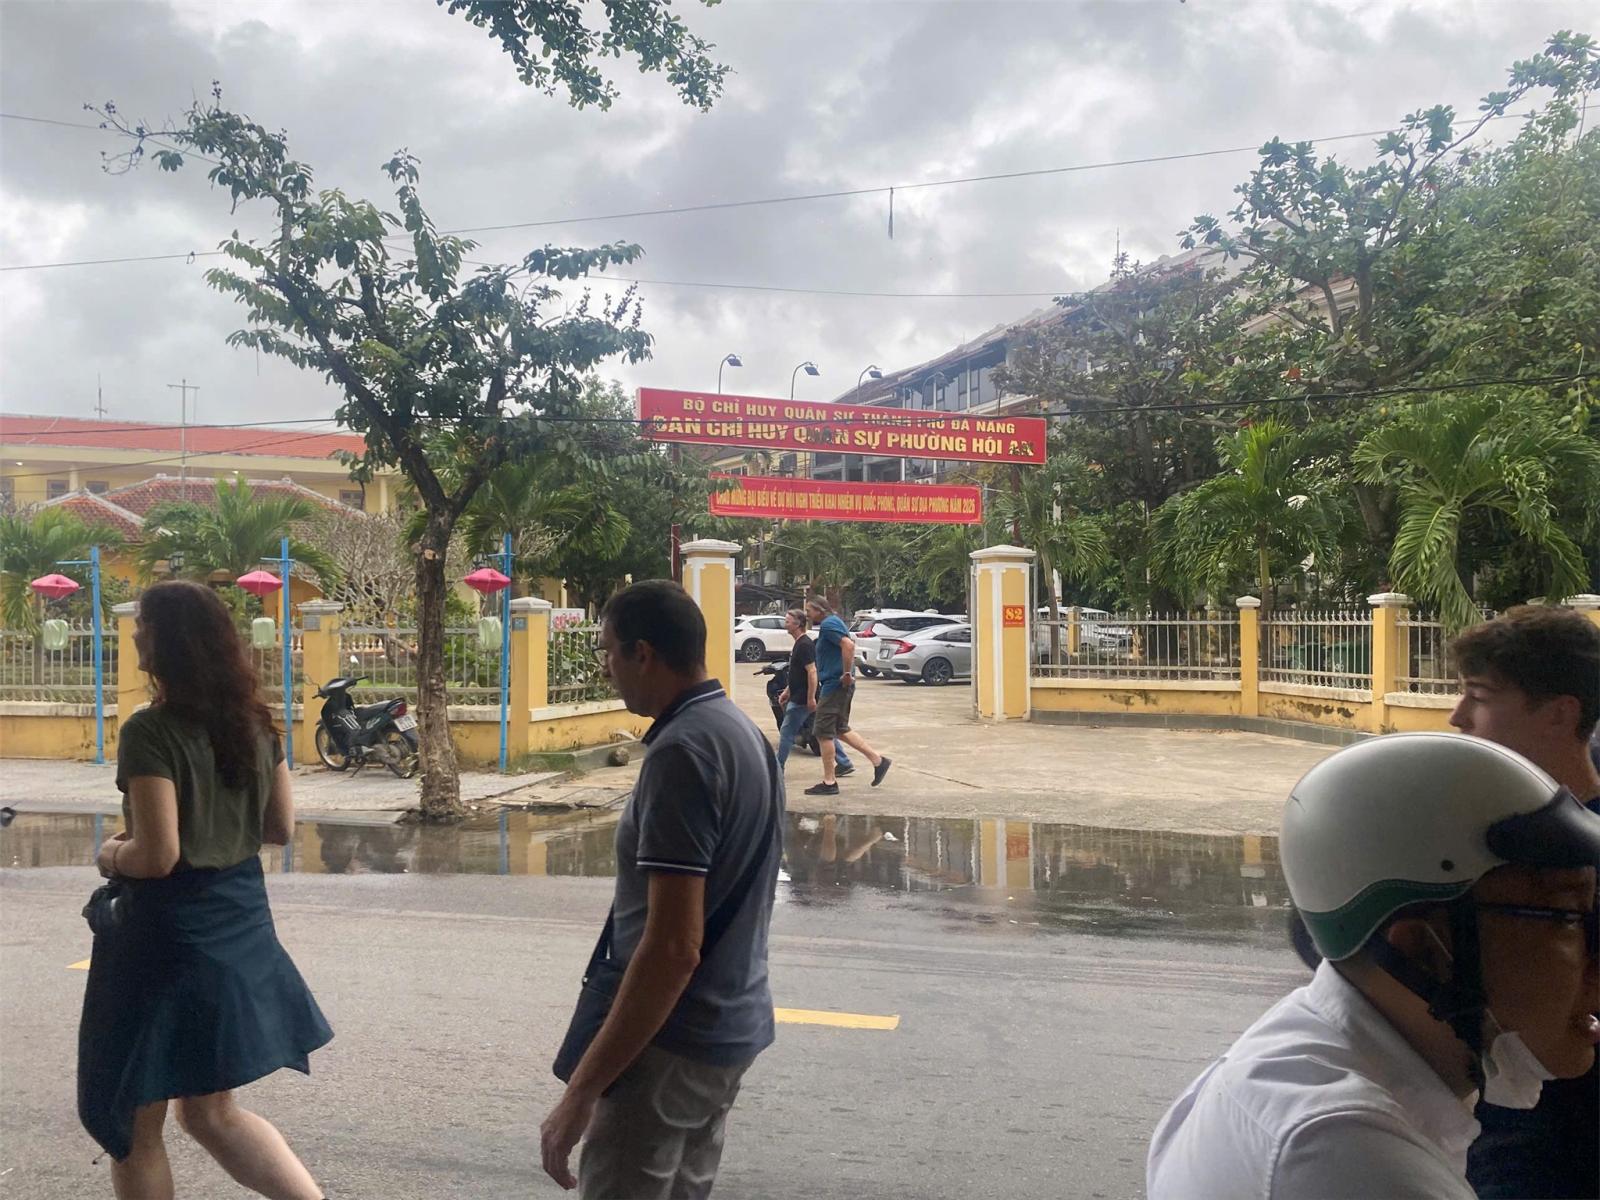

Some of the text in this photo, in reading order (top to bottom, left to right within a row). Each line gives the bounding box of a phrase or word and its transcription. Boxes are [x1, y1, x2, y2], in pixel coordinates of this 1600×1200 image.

[683, 397, 705, 414] BỘ
[746, 404, 777, 417] HUY
[784, 407, 827, 421] QUÂN
[833, 411, 855, 425] SỰ
[862, 412, 911, 427] THÀNH
[707, 416, 743, 437] CHỈ
[748, 422, 788, 440] HUY
[854, 430, 882, 449] SỰ
[887, 431, 967, 452] PHƯỜNG
[972, 436, 1002, 456] HỘI
[1005, 607, 1023, 621] 82
